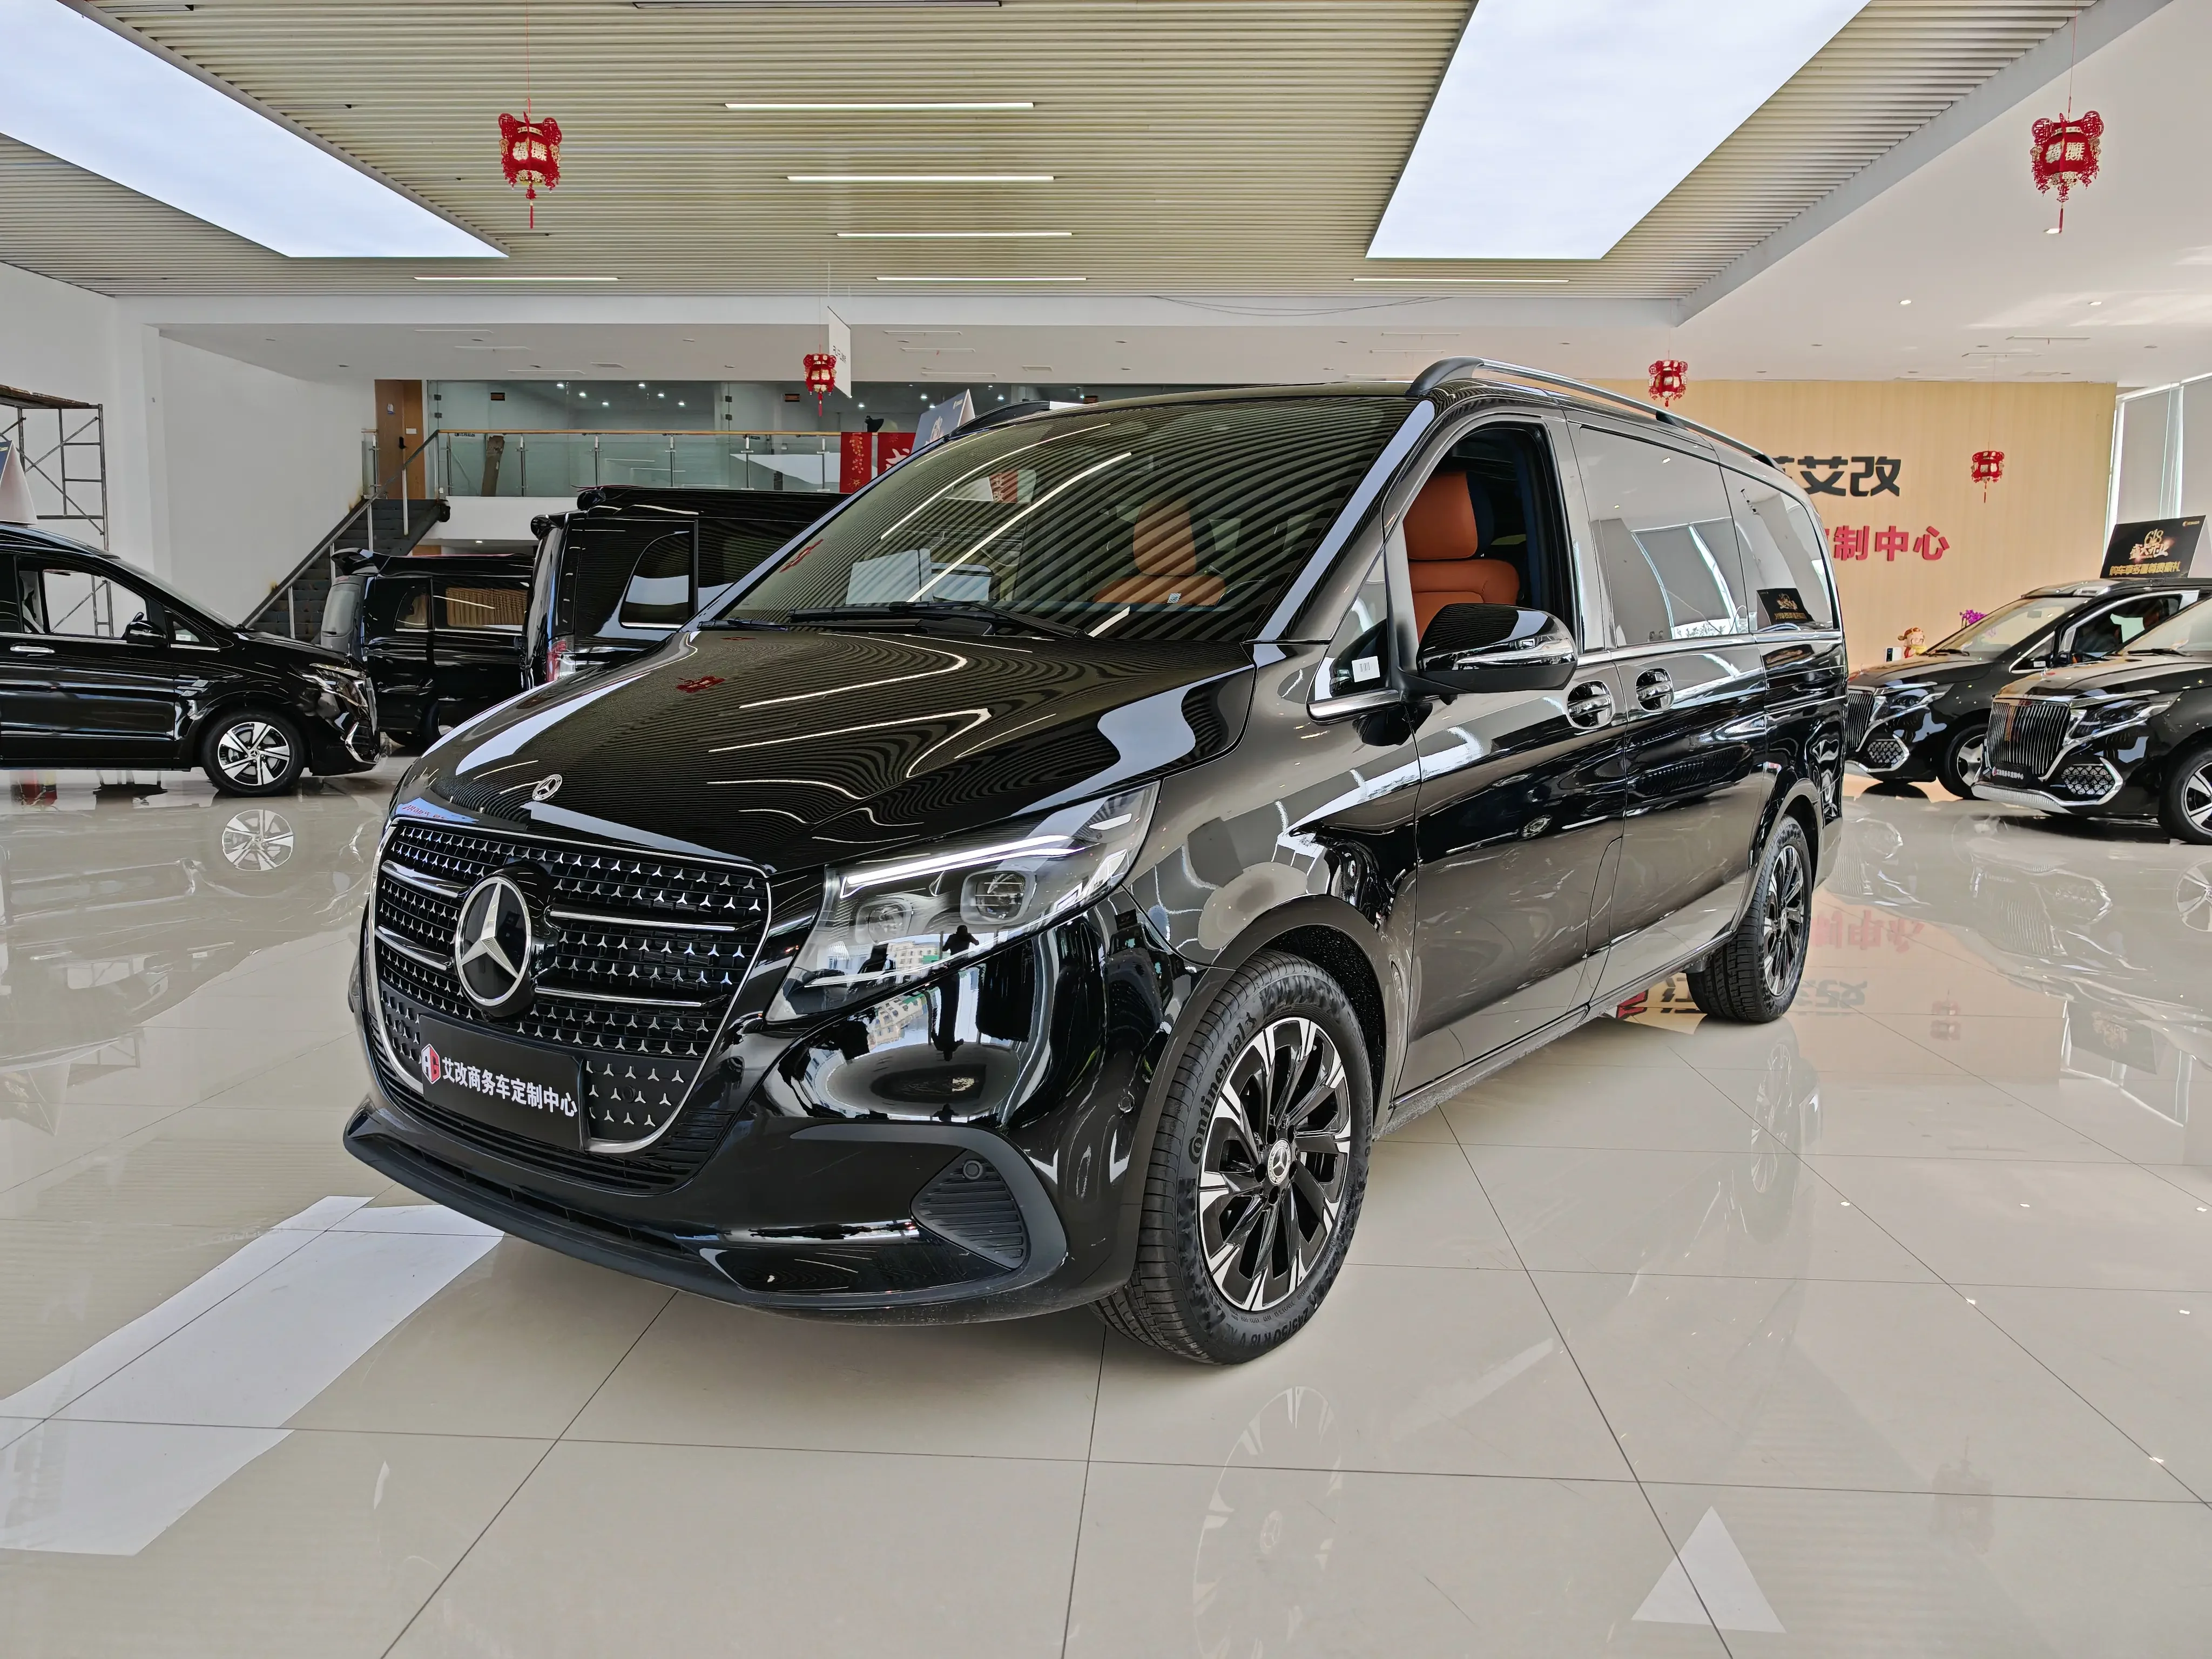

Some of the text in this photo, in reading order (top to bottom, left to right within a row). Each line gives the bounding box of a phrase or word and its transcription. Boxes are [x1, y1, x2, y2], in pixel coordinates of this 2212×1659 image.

[1826, 525, 1950, 561] 制中心
[442, 1056, 578, 1117] 艾改商务车定制中心
